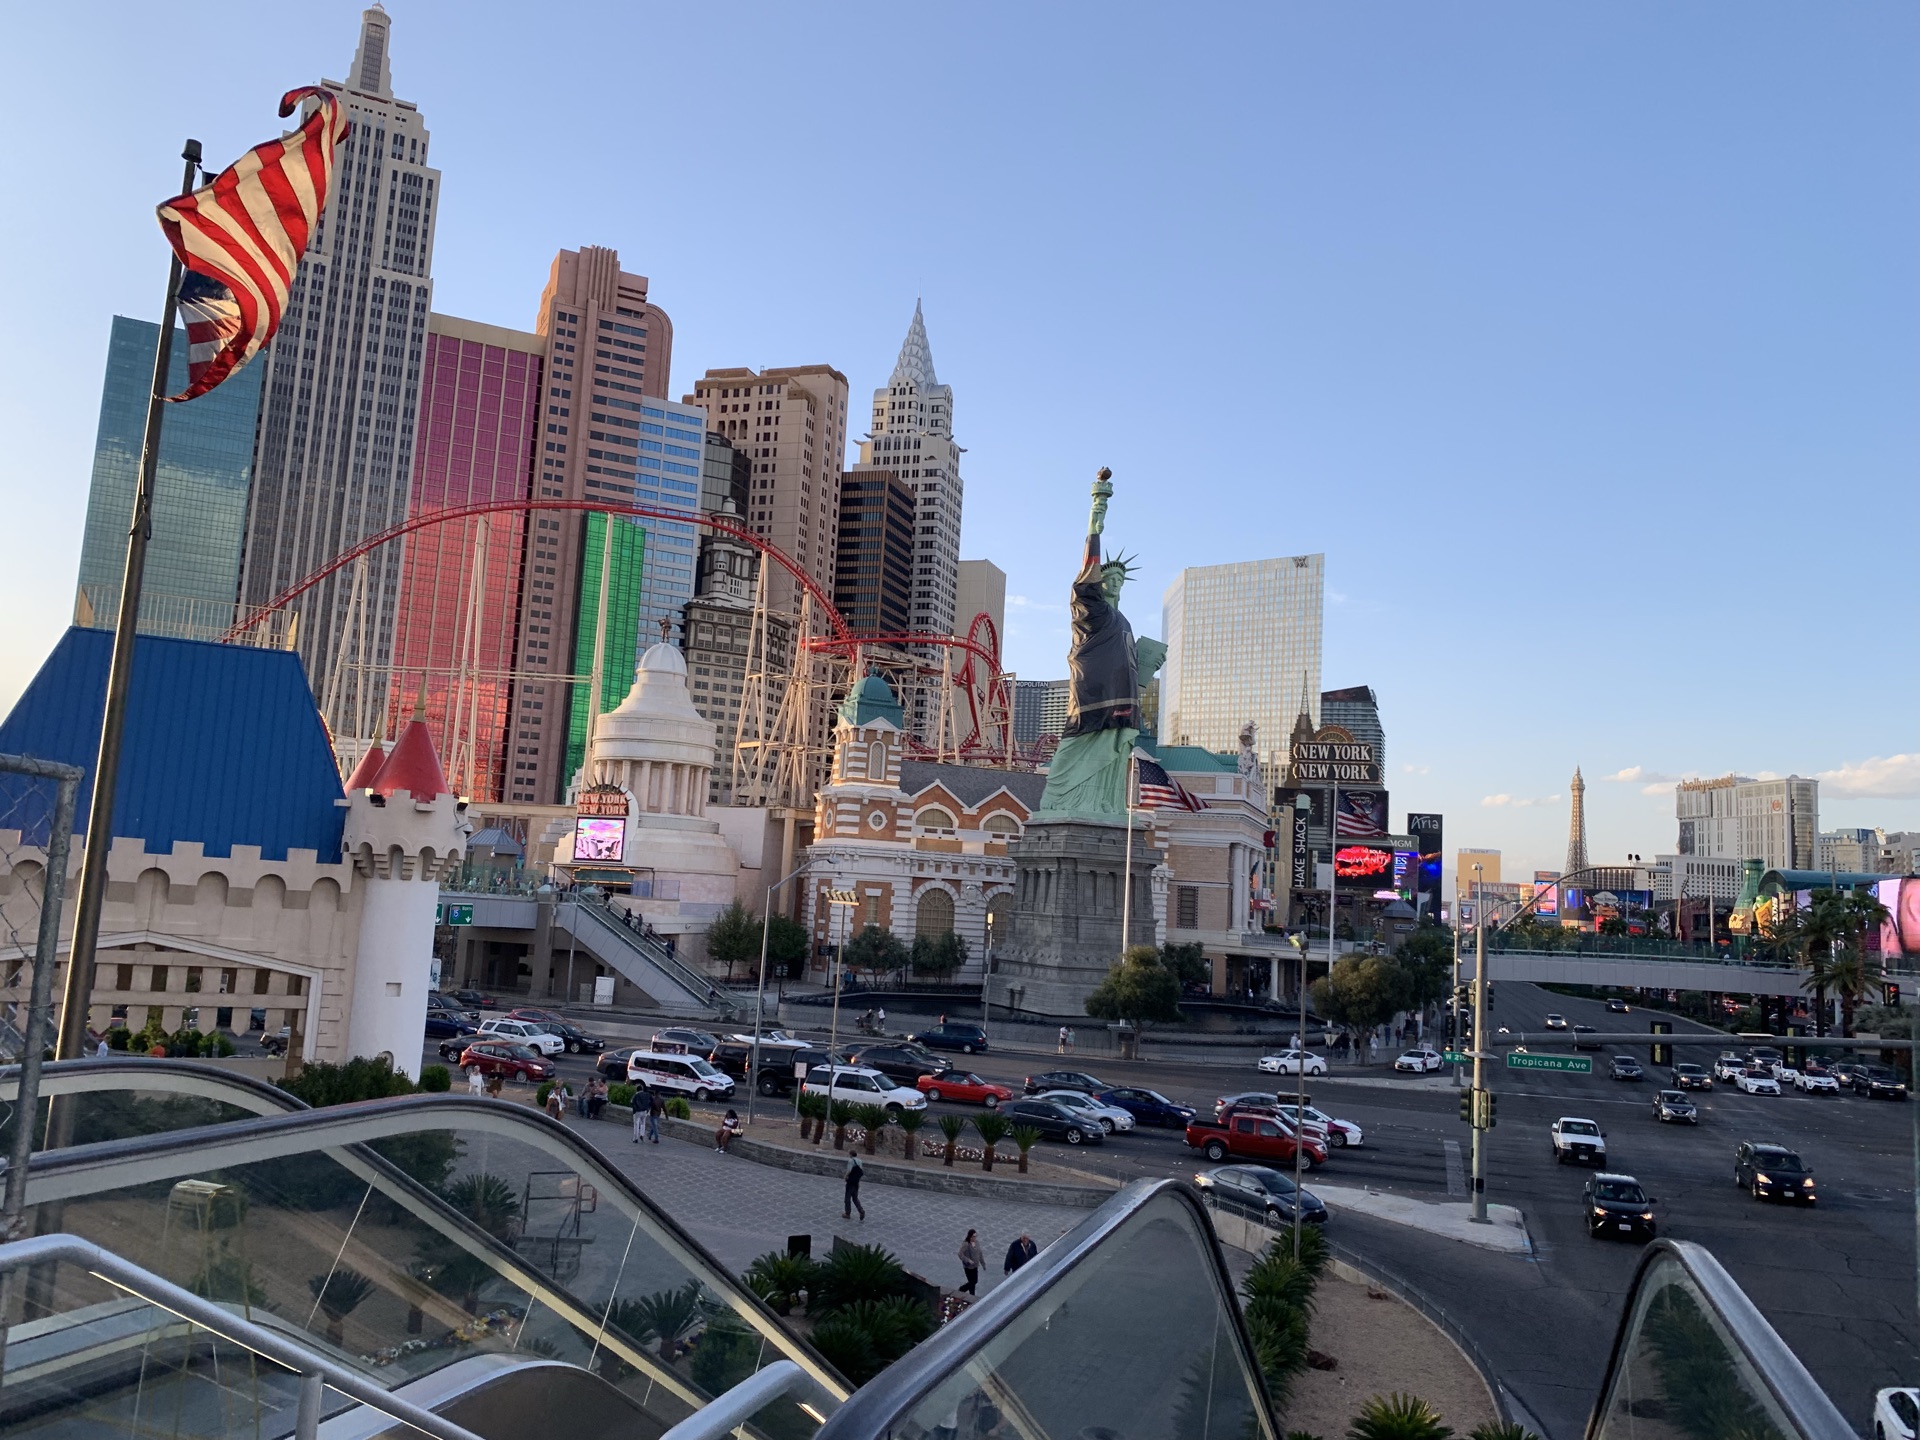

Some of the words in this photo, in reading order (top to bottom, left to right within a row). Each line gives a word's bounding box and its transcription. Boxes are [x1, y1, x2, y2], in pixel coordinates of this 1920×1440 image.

[1299, 744, 1330, 759] NEW
[1333, 744, 1371, 760] YORK
[1299, 763, 1329, 778] NEW
[1333, 764, 1370, 780] YORK
[577, 793, 599, 804] NEW
[601, 793, 627, 804] YORK
[577, 803, 599, 814] NEW
[600, 804, 626, 815] YORK
[1411, 815, 1440, 829] Aria
[1294, 817, 1306, 854] SHACK
[1390, 840, 1412, 848] MGM
[1294, 858, 1306, 888] HAKE
[1511, 1056, 1562, 1069] Tropicana
[1567, 1060, 1587, 1070] Ave
